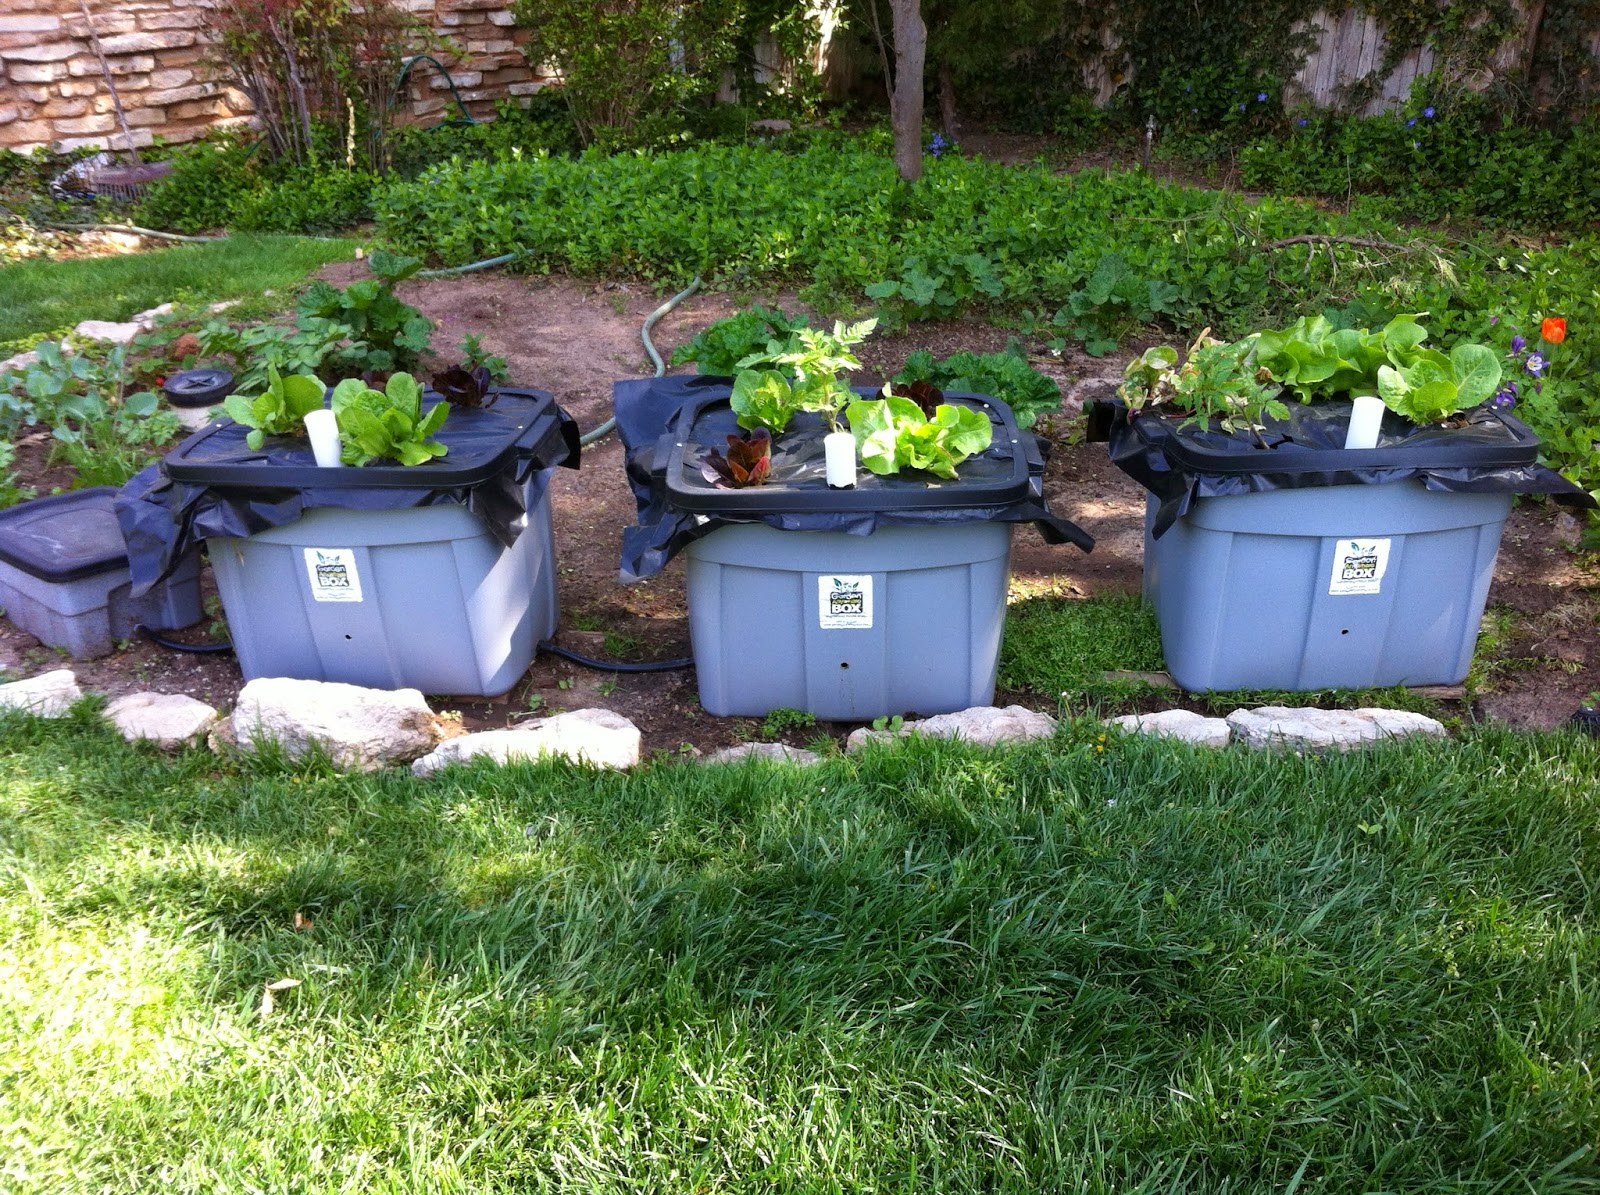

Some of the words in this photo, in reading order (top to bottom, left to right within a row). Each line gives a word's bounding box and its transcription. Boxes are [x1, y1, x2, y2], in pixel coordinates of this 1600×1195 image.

[1343, 568, 1374, 578] BOX
[319, 577, 348, 587] BOX
[831, 604, 861, 613] BOX
